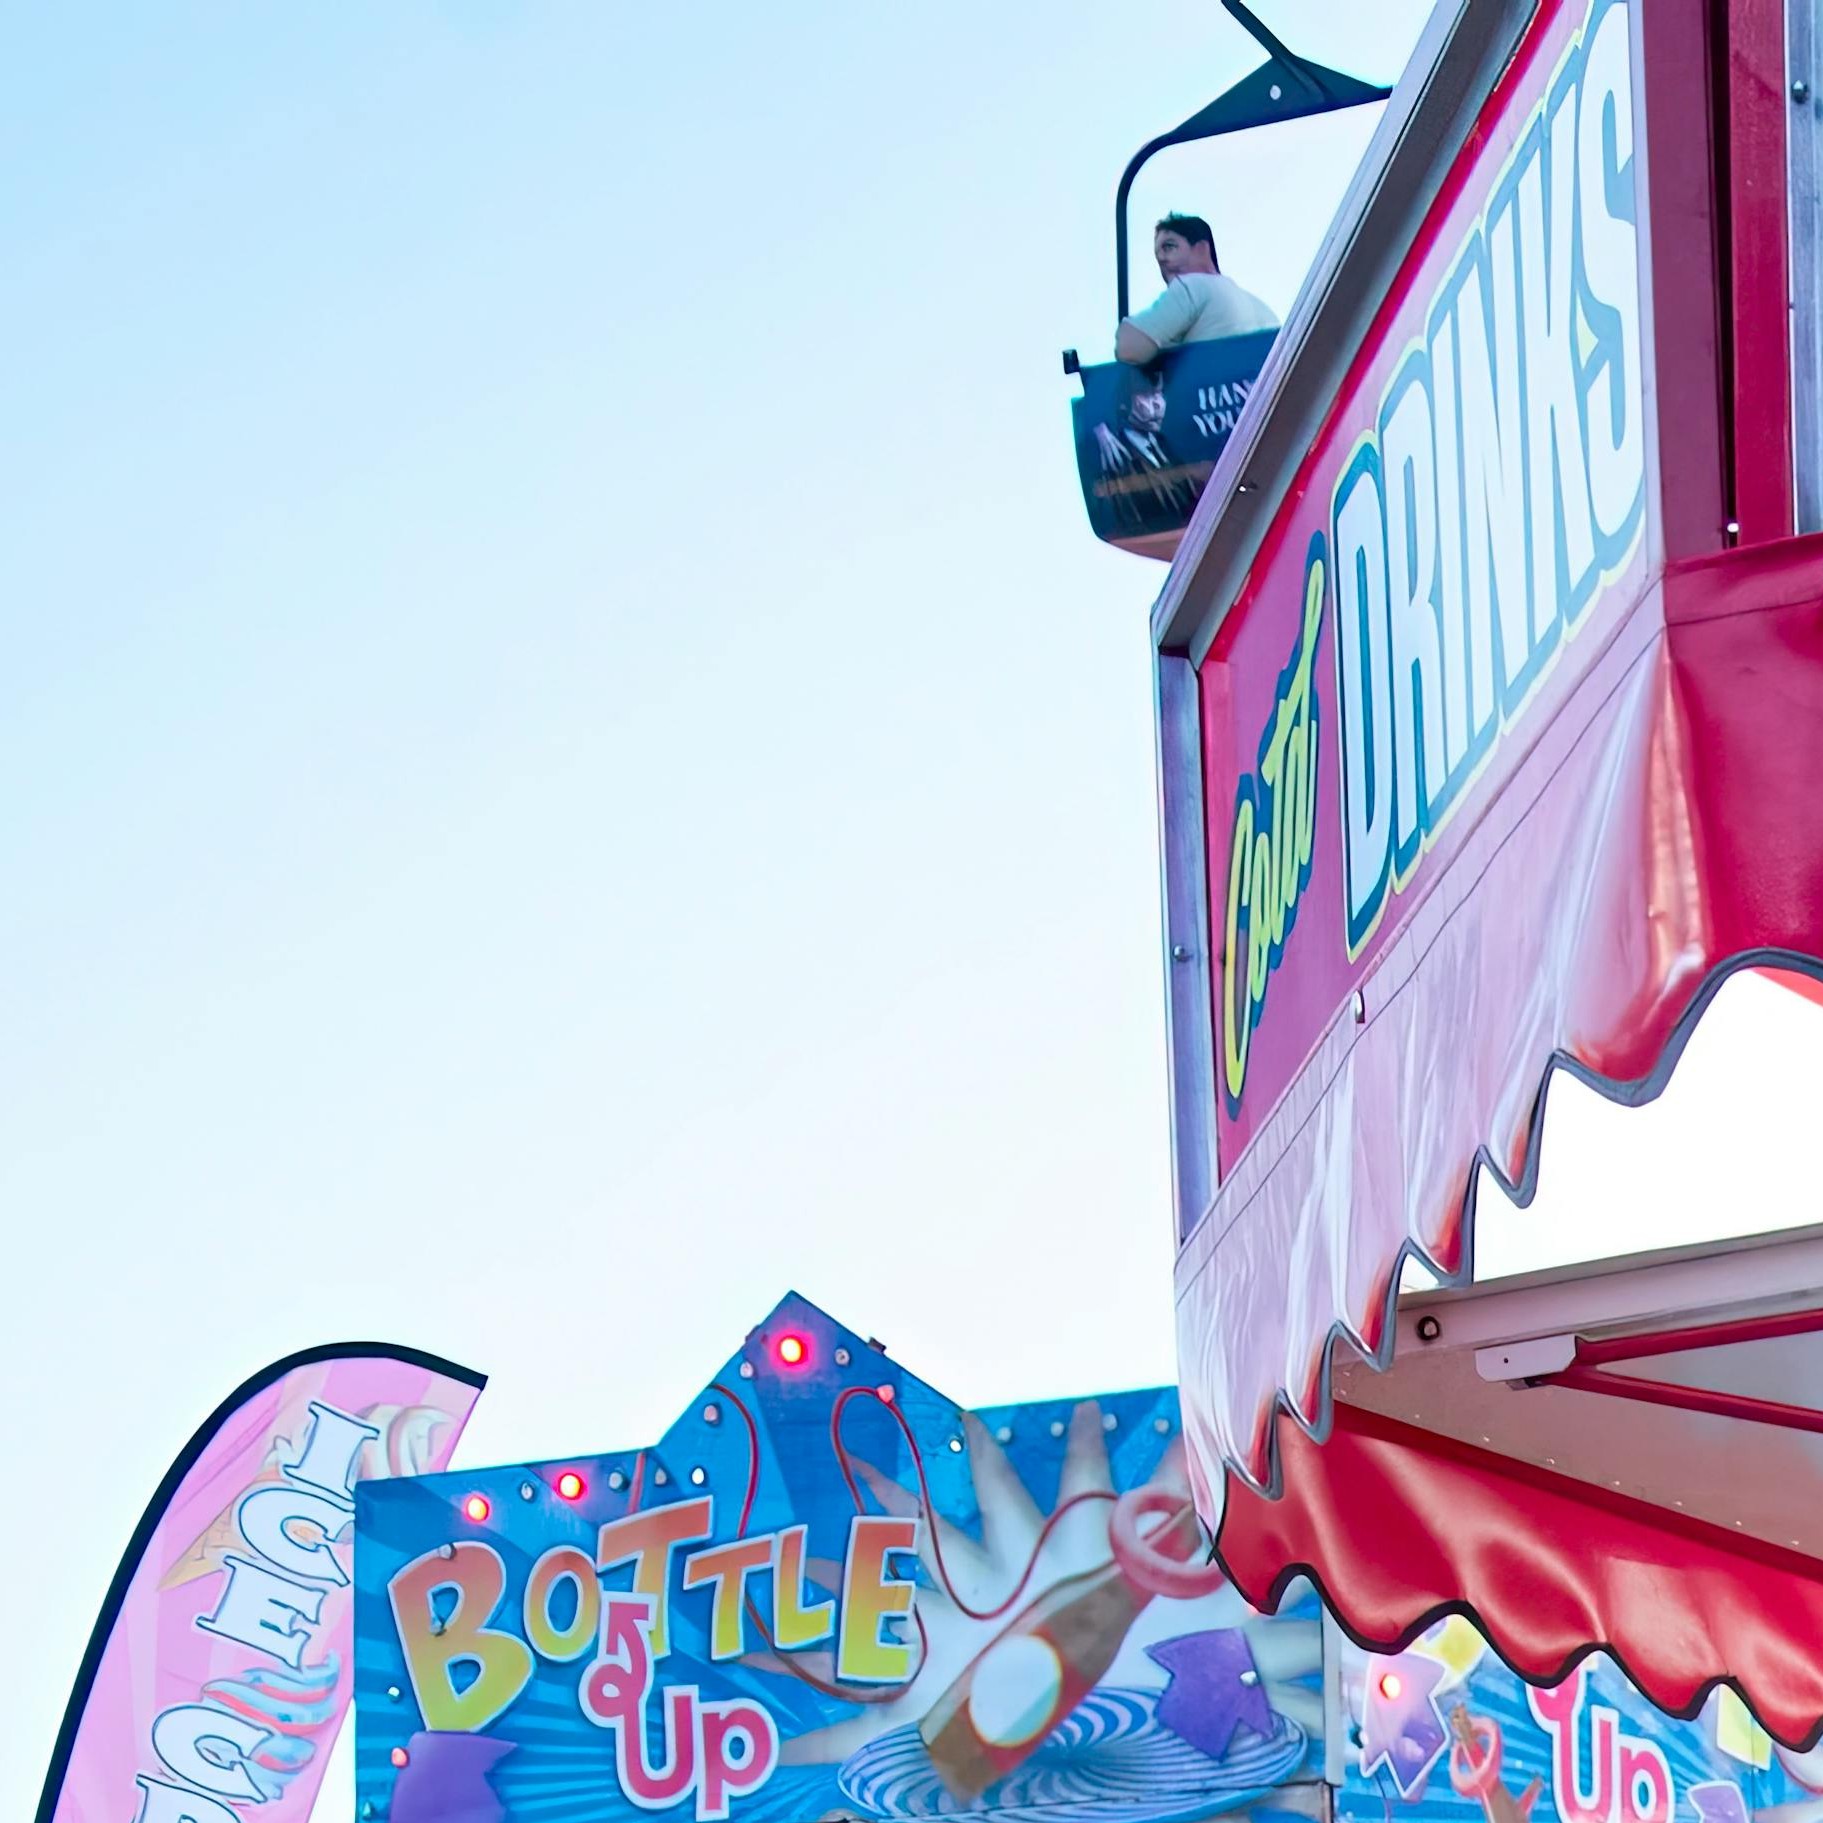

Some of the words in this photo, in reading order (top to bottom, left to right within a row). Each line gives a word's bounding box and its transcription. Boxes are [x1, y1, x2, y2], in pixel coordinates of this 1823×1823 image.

[1225, 558, 1324, 1098] Cold
[1335, 4, 1644, 922] DRINKS
[195, 1400, 381, 1671] ICE
[387, 1495, 919, 1732] BOTTLE
[580, 1592, 779, 1822] Up
